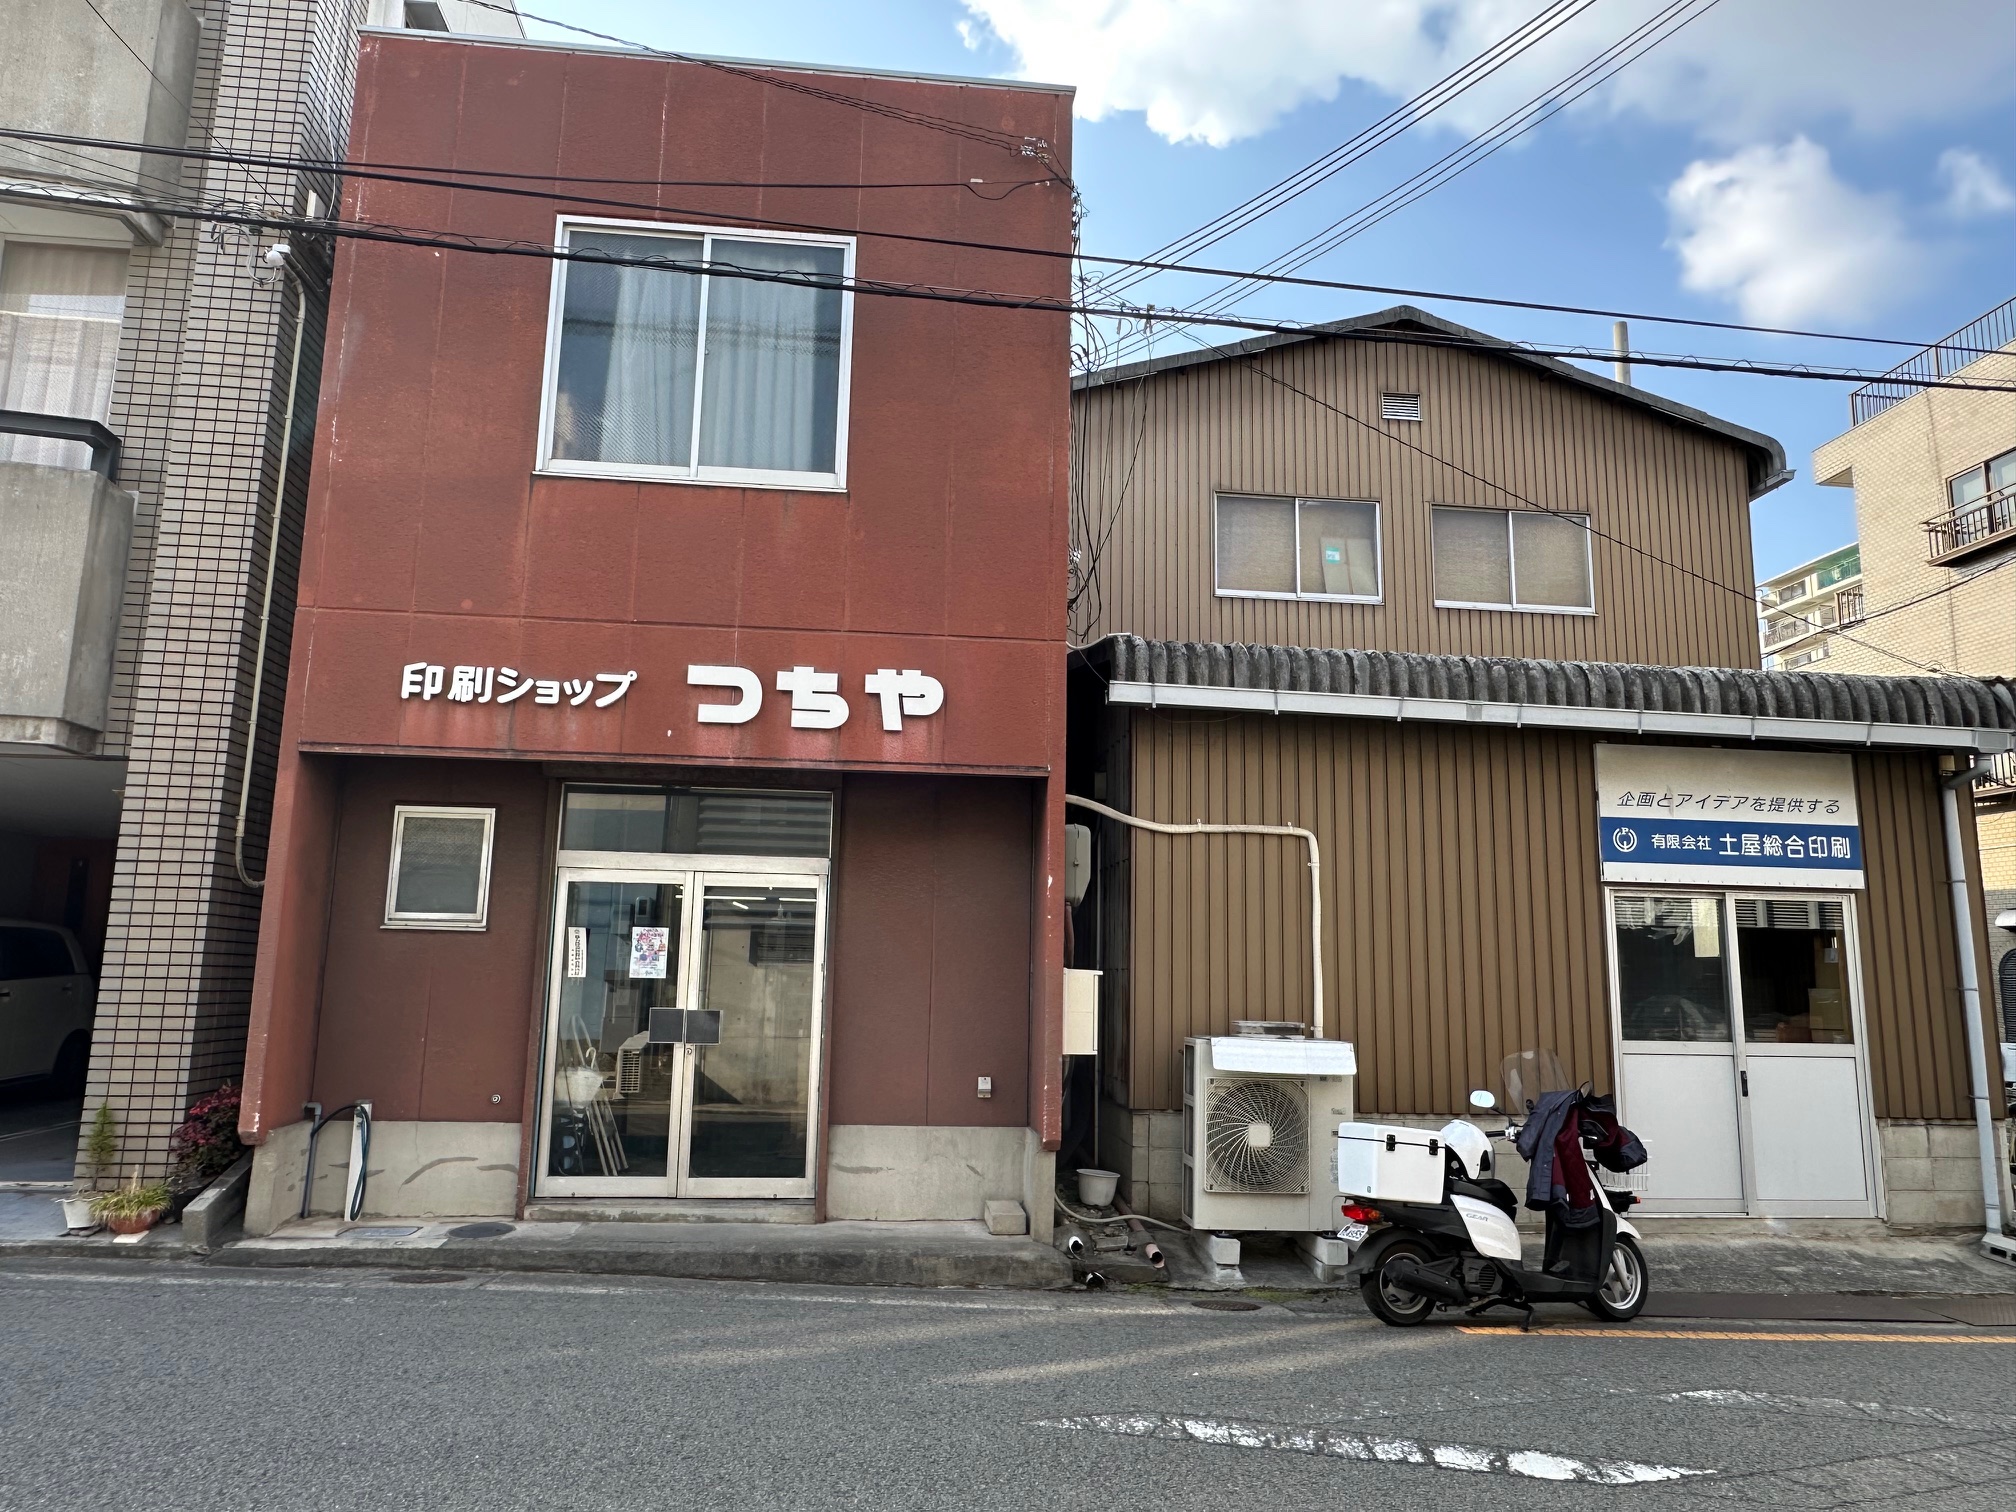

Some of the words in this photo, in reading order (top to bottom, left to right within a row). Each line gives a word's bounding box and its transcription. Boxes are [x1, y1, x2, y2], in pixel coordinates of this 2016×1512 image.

[400, 661, 638, 708] 印刷ショップ
[687, 664, 945, 731] つちや
[1616, 790, 1841, 814] 企画とアイデアを提供する
[1651, 833, 1712, 851] 有限会社
[1718, 832, 1851, 859] 土屋総合印刷
[1466, 1213, 1489, 1222] GEAR
